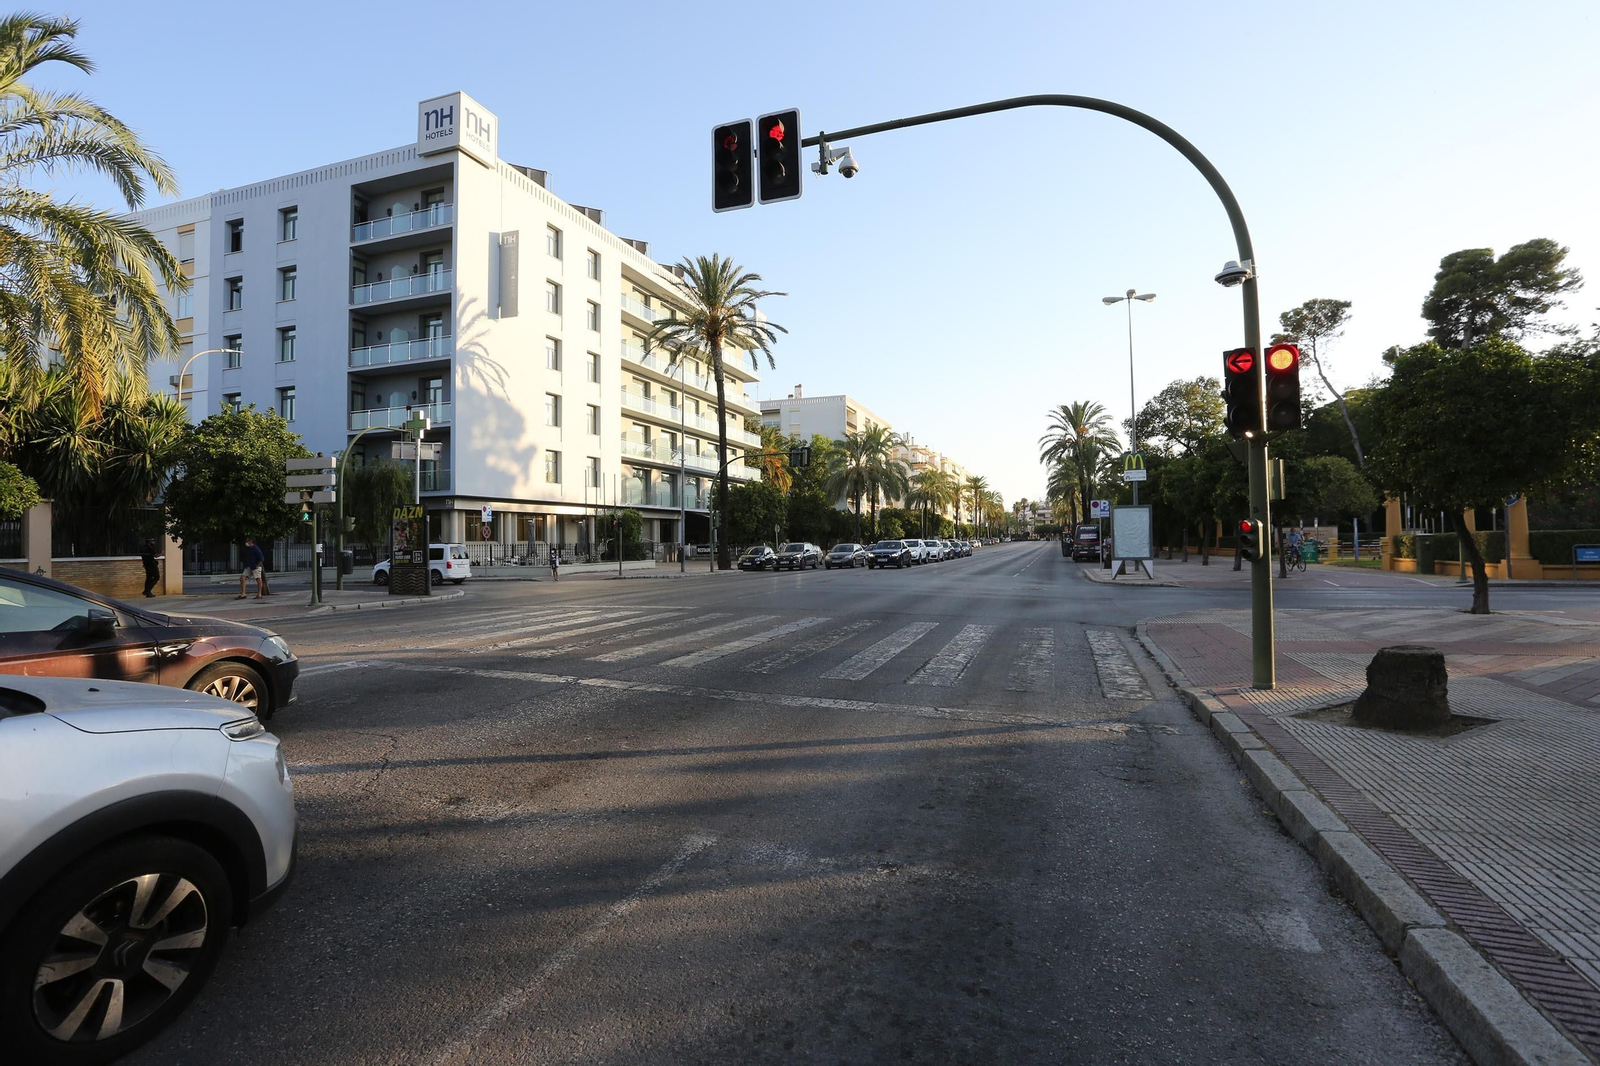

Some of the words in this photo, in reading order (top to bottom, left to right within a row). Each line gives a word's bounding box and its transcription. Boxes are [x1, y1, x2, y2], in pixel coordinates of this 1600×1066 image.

[425, 127, 453, 140] HOTELS
[465, 131, 490, 152] HOTELS
[393, 506, 423, 519] DAZN
